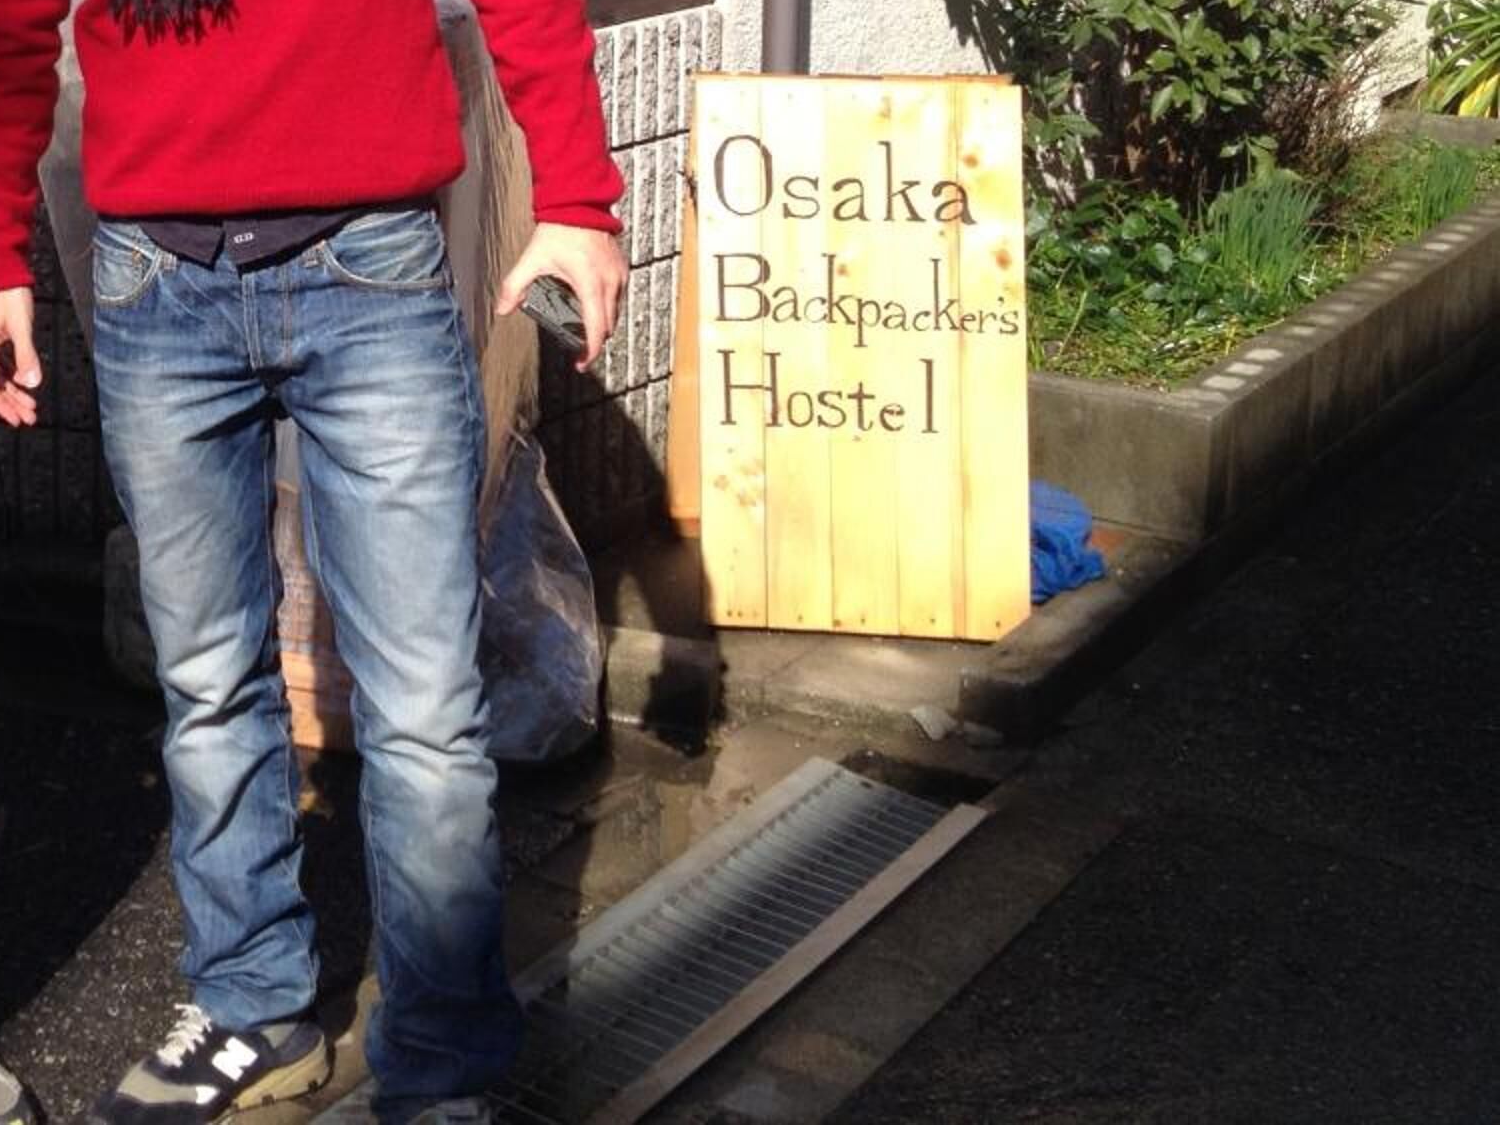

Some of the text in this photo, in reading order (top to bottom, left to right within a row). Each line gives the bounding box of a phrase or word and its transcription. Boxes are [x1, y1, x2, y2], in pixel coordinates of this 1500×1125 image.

[713, 134, 978, 227] Osaka
[712, 252, 1020, 348] Backpacker's
[716, 348, 940, 434] Hostel
